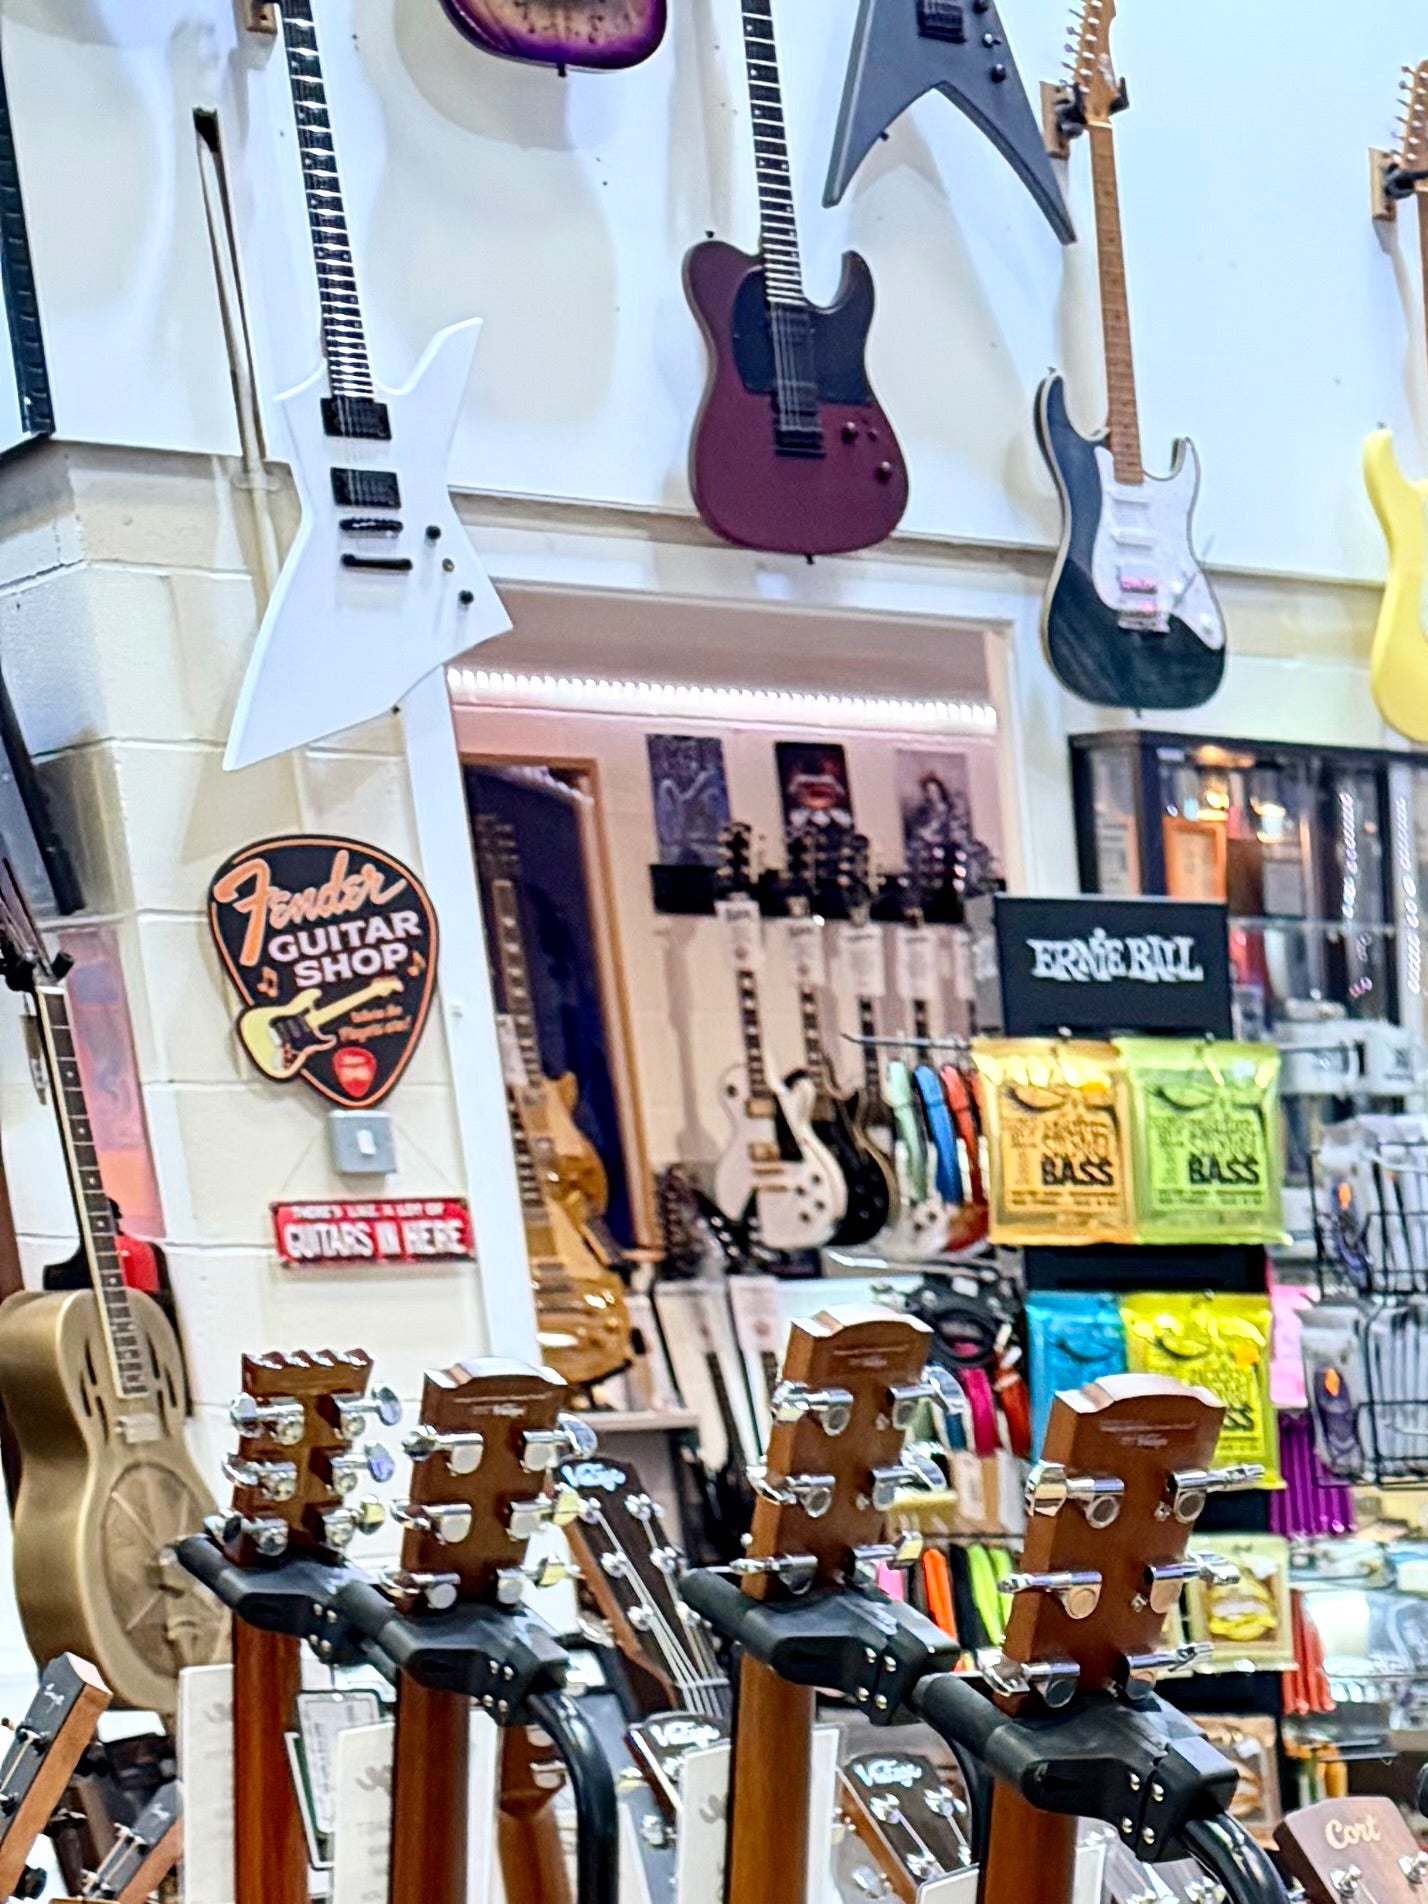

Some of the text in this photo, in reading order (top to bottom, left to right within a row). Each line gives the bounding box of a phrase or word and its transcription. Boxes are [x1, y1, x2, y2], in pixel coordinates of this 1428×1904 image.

[213, 849, 407, 966] Fender
[268, 910, 422, 962] GUITAR
[1026, 927, 1204, 982] ERNIE BALL
[293, 943, 408, 987] SHOP
[1041, 1154, 1115, 1186] BASS
[1187, 1153, 1261, 1186] BASS
[284, 1221, 374, 1259] GUITARS
[402, 1218, 468, 1255] HERE
[1325, 1818, 1381, 1851] Cort
